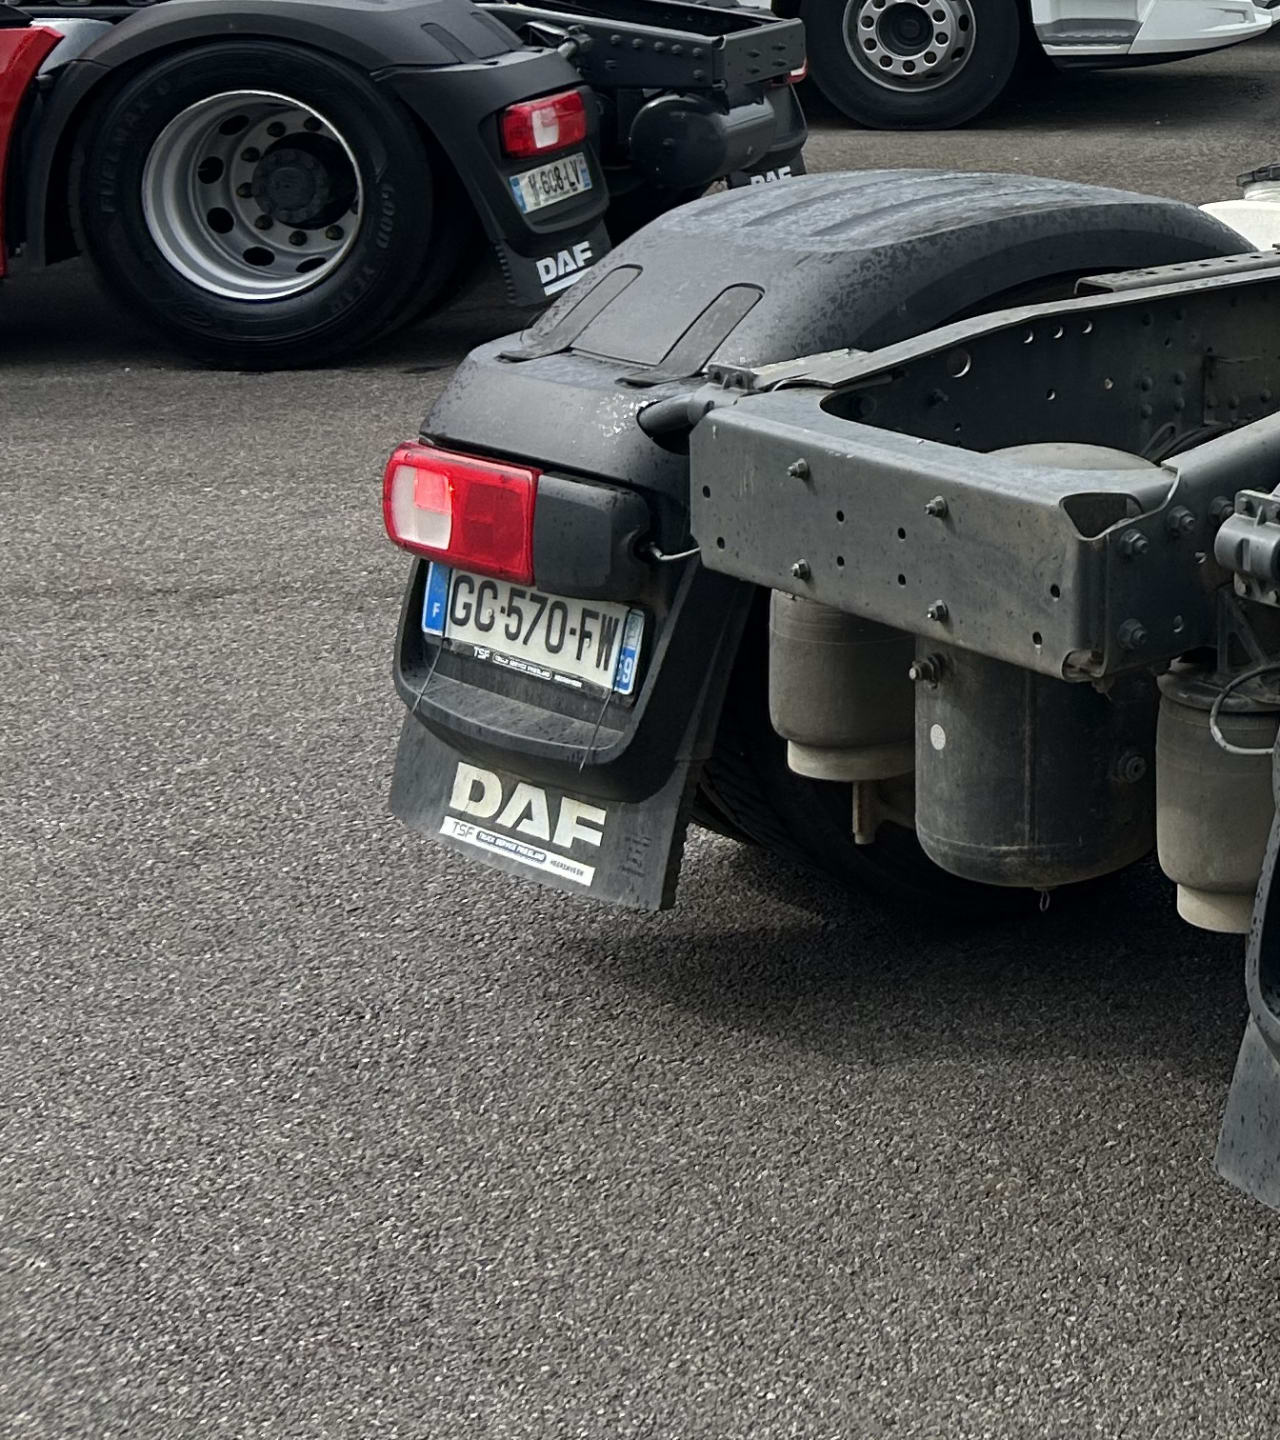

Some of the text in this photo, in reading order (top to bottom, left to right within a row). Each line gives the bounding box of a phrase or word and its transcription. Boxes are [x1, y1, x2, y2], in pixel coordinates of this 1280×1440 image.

[536, 241, 593, 284] DAF
[431, 602, 440, 617] F
[450, 574, 620, 672] GC-570-FW
[449, 761, 607, 849] DAF
[452, 821, 475, 841] TSF
